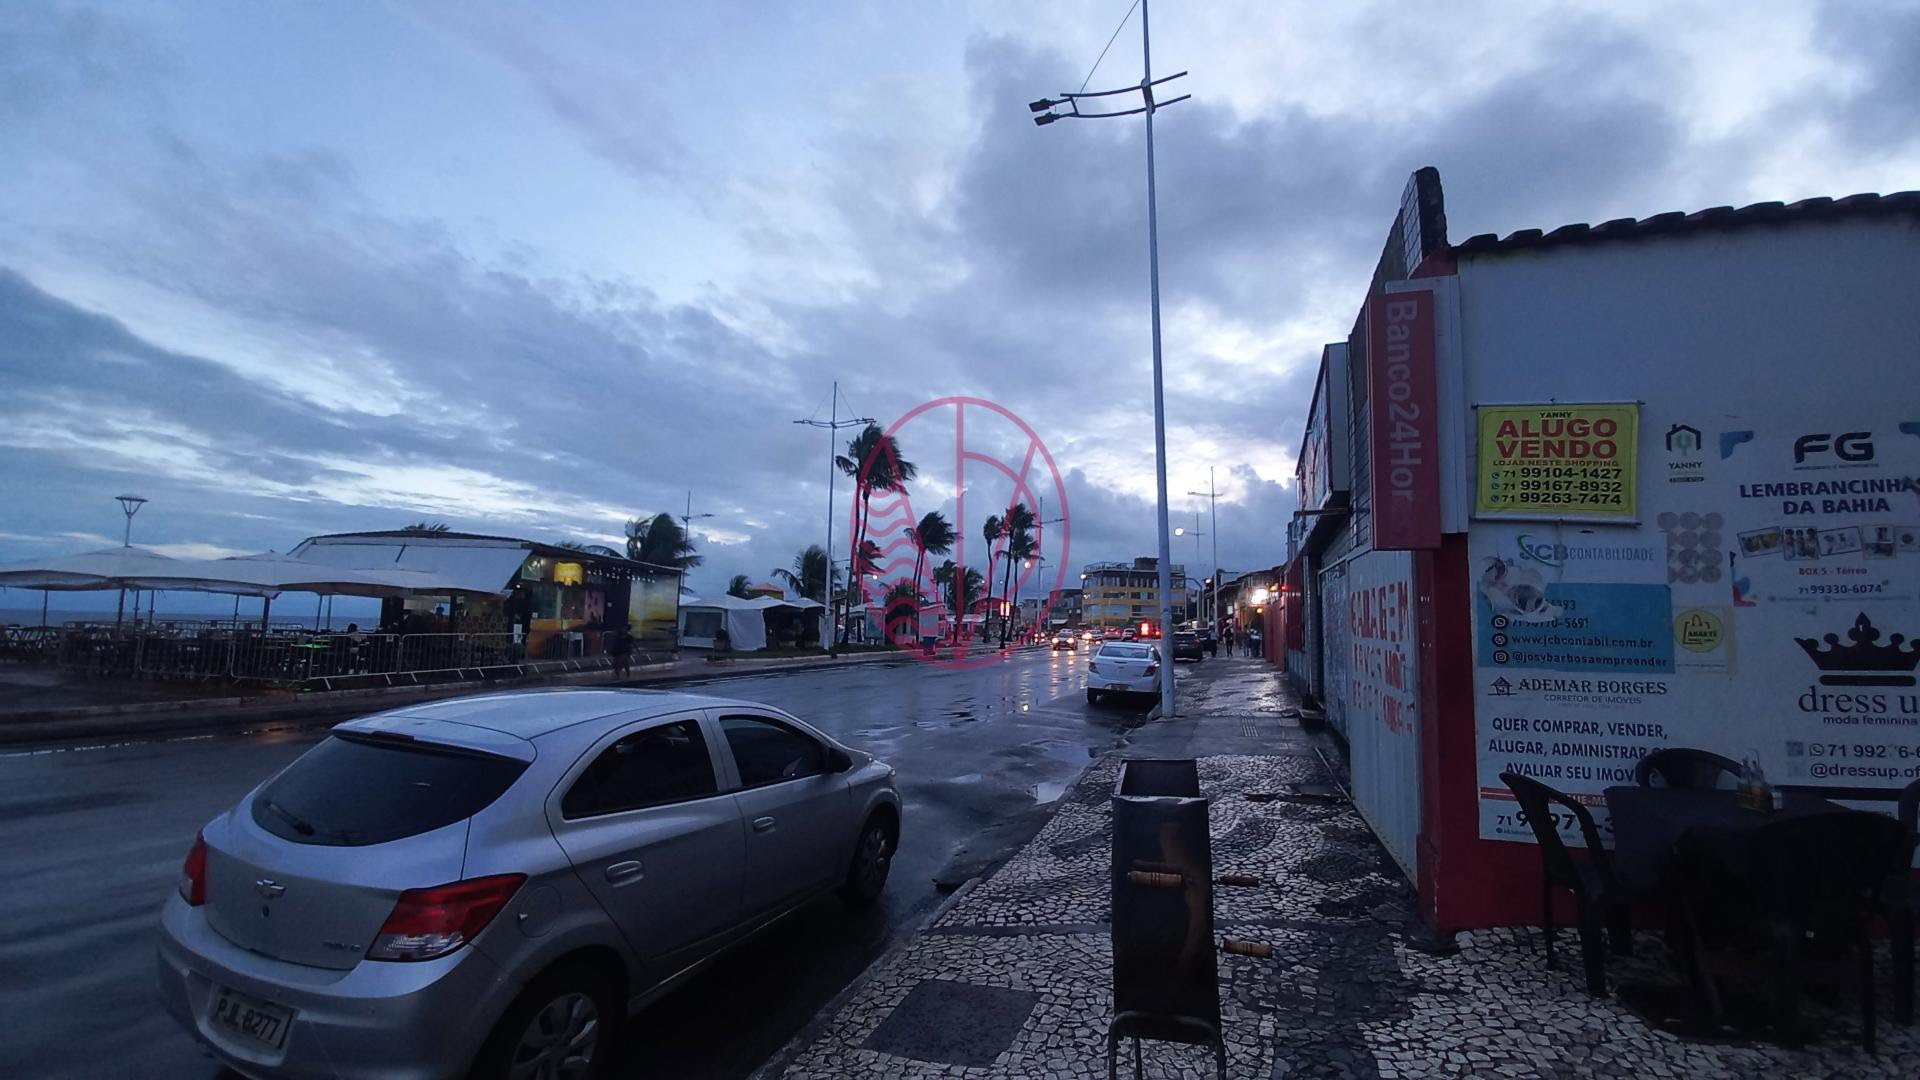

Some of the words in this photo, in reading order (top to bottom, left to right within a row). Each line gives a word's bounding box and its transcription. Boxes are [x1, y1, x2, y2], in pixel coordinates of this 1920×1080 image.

[1540, 412, 1572, 420] YANNY
[1496, 418, 1618, 438] ALUGO
[1496, 439, 1618, 459] VENDO
[1794, 432, 1875, 463] FG
[1564, 460, 1619, 468] SHOPPING
[1668, 461, 1703, 470] YANNY
[1503, 470, 1516, 478] 71
[1521, 467, 1623, 480] 99104-1427
[1503, 482, 1516, 491] 71
[1520, 480, 1622, 493] 99167-8932
[1502, 495, 1515, 503] 71
[1520, 492, 1622, 505] 99263-7474
[1783, 501, 1816, 515] DA
[1822, 498, 1891, 514] BAHIA
[1519, 544, 1569, 561] JCB
[1569, 547, 1656, 561] CONTABILIDADE
[1810, 584, 1882, 595] 99330-6074
[1518, 678, 1591, 694] ADEMAR
[1597, 680, 1668, 696] BORGES
[1544, 694, 1590, 703] CORRETOR
[1591, 695, 1602, 704] DE
[1798, 685, 1887, 714] dress
[1823, 715, 1859, 725] moda
[1862, 715, 1918, 726] feminina
[1493, 717, 1528, 732] QUER
[1533, 719, 1604, 737] COMPRAR,
[1607, 722, 1669, 740] VENDER,
[1489, 739, 1548, 757] ALUGAR,
[1552, 742, 1648, 760] ADMINISTRAR
[1827, 744, 1846, 757] 71
[1853, 744, 1920, 759] 9926-
[1506, 763, 1562, 778] AVALIAR
[1566, 766, 1591, 780] SEU
[1597, 763, 1637, 782] IMÓV
[1497, 815, 1512, 826] 71
